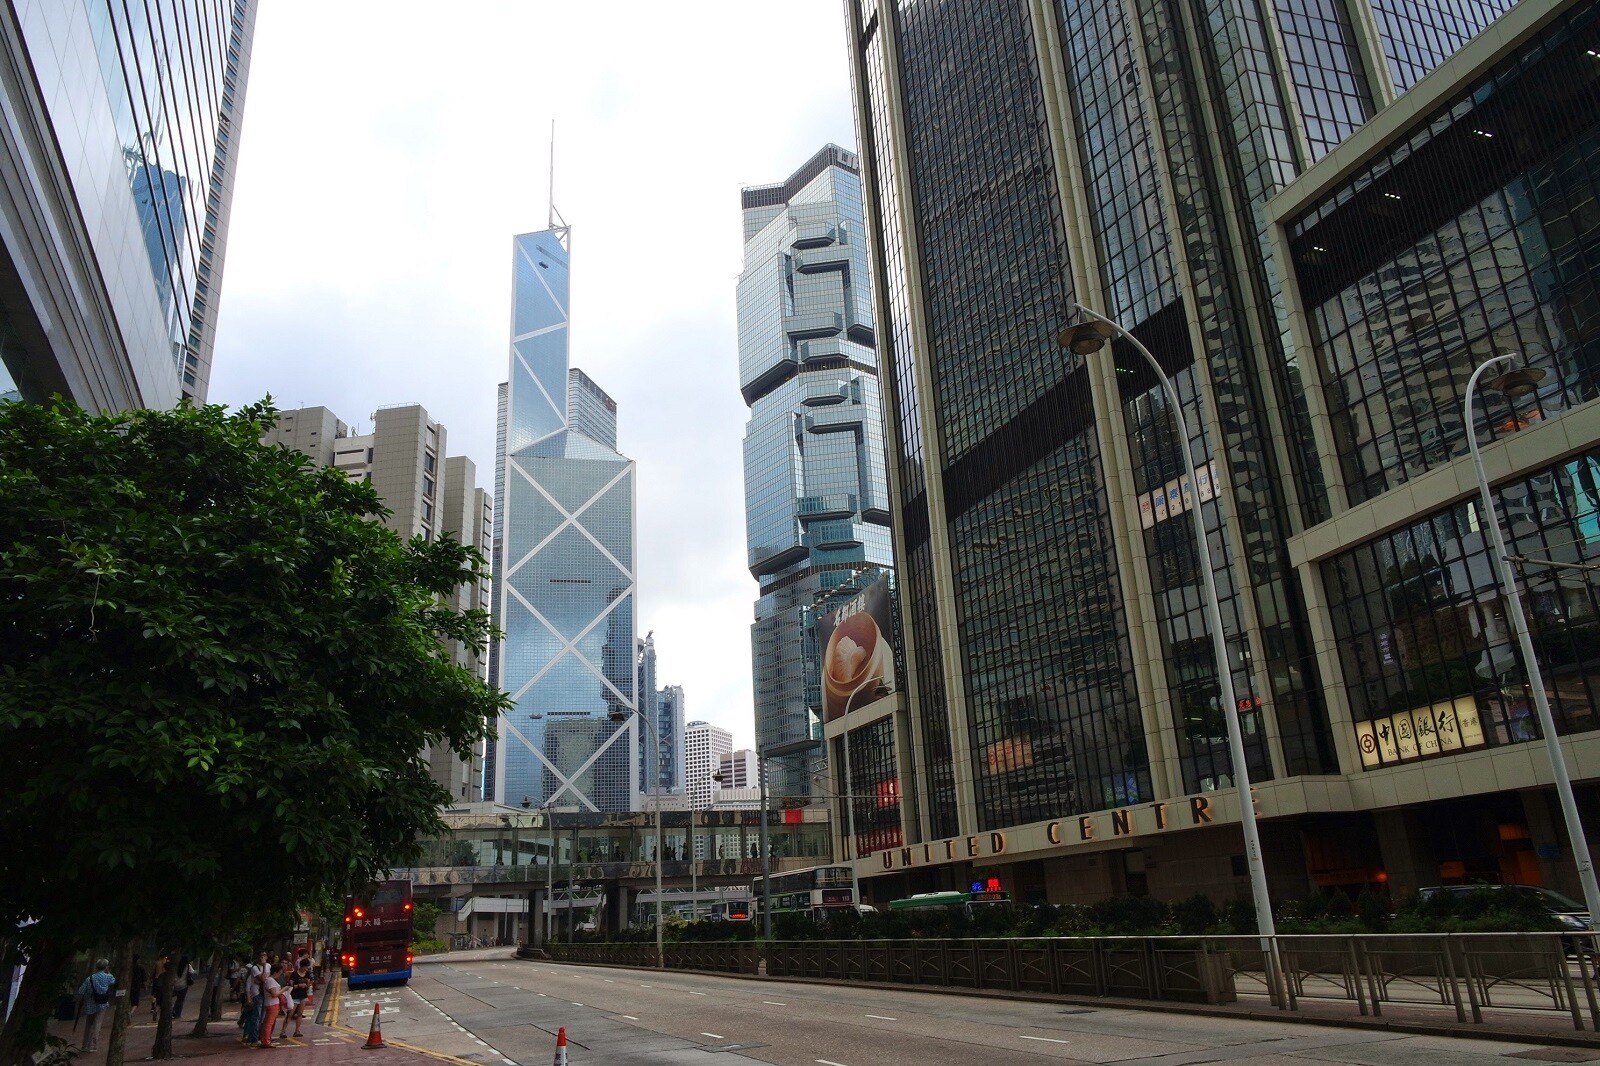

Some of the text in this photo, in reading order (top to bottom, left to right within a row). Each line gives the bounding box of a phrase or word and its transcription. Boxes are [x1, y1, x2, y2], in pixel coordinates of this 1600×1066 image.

[1378, 711, 1454, 746] 中國銀行
[1387, 745, 1410, 758] BANK
[1425, 737, 1453, 750] CHNA
[882, 835, 1006, 870] UNITED
[1047, 788, 1258, 845] CENTR
